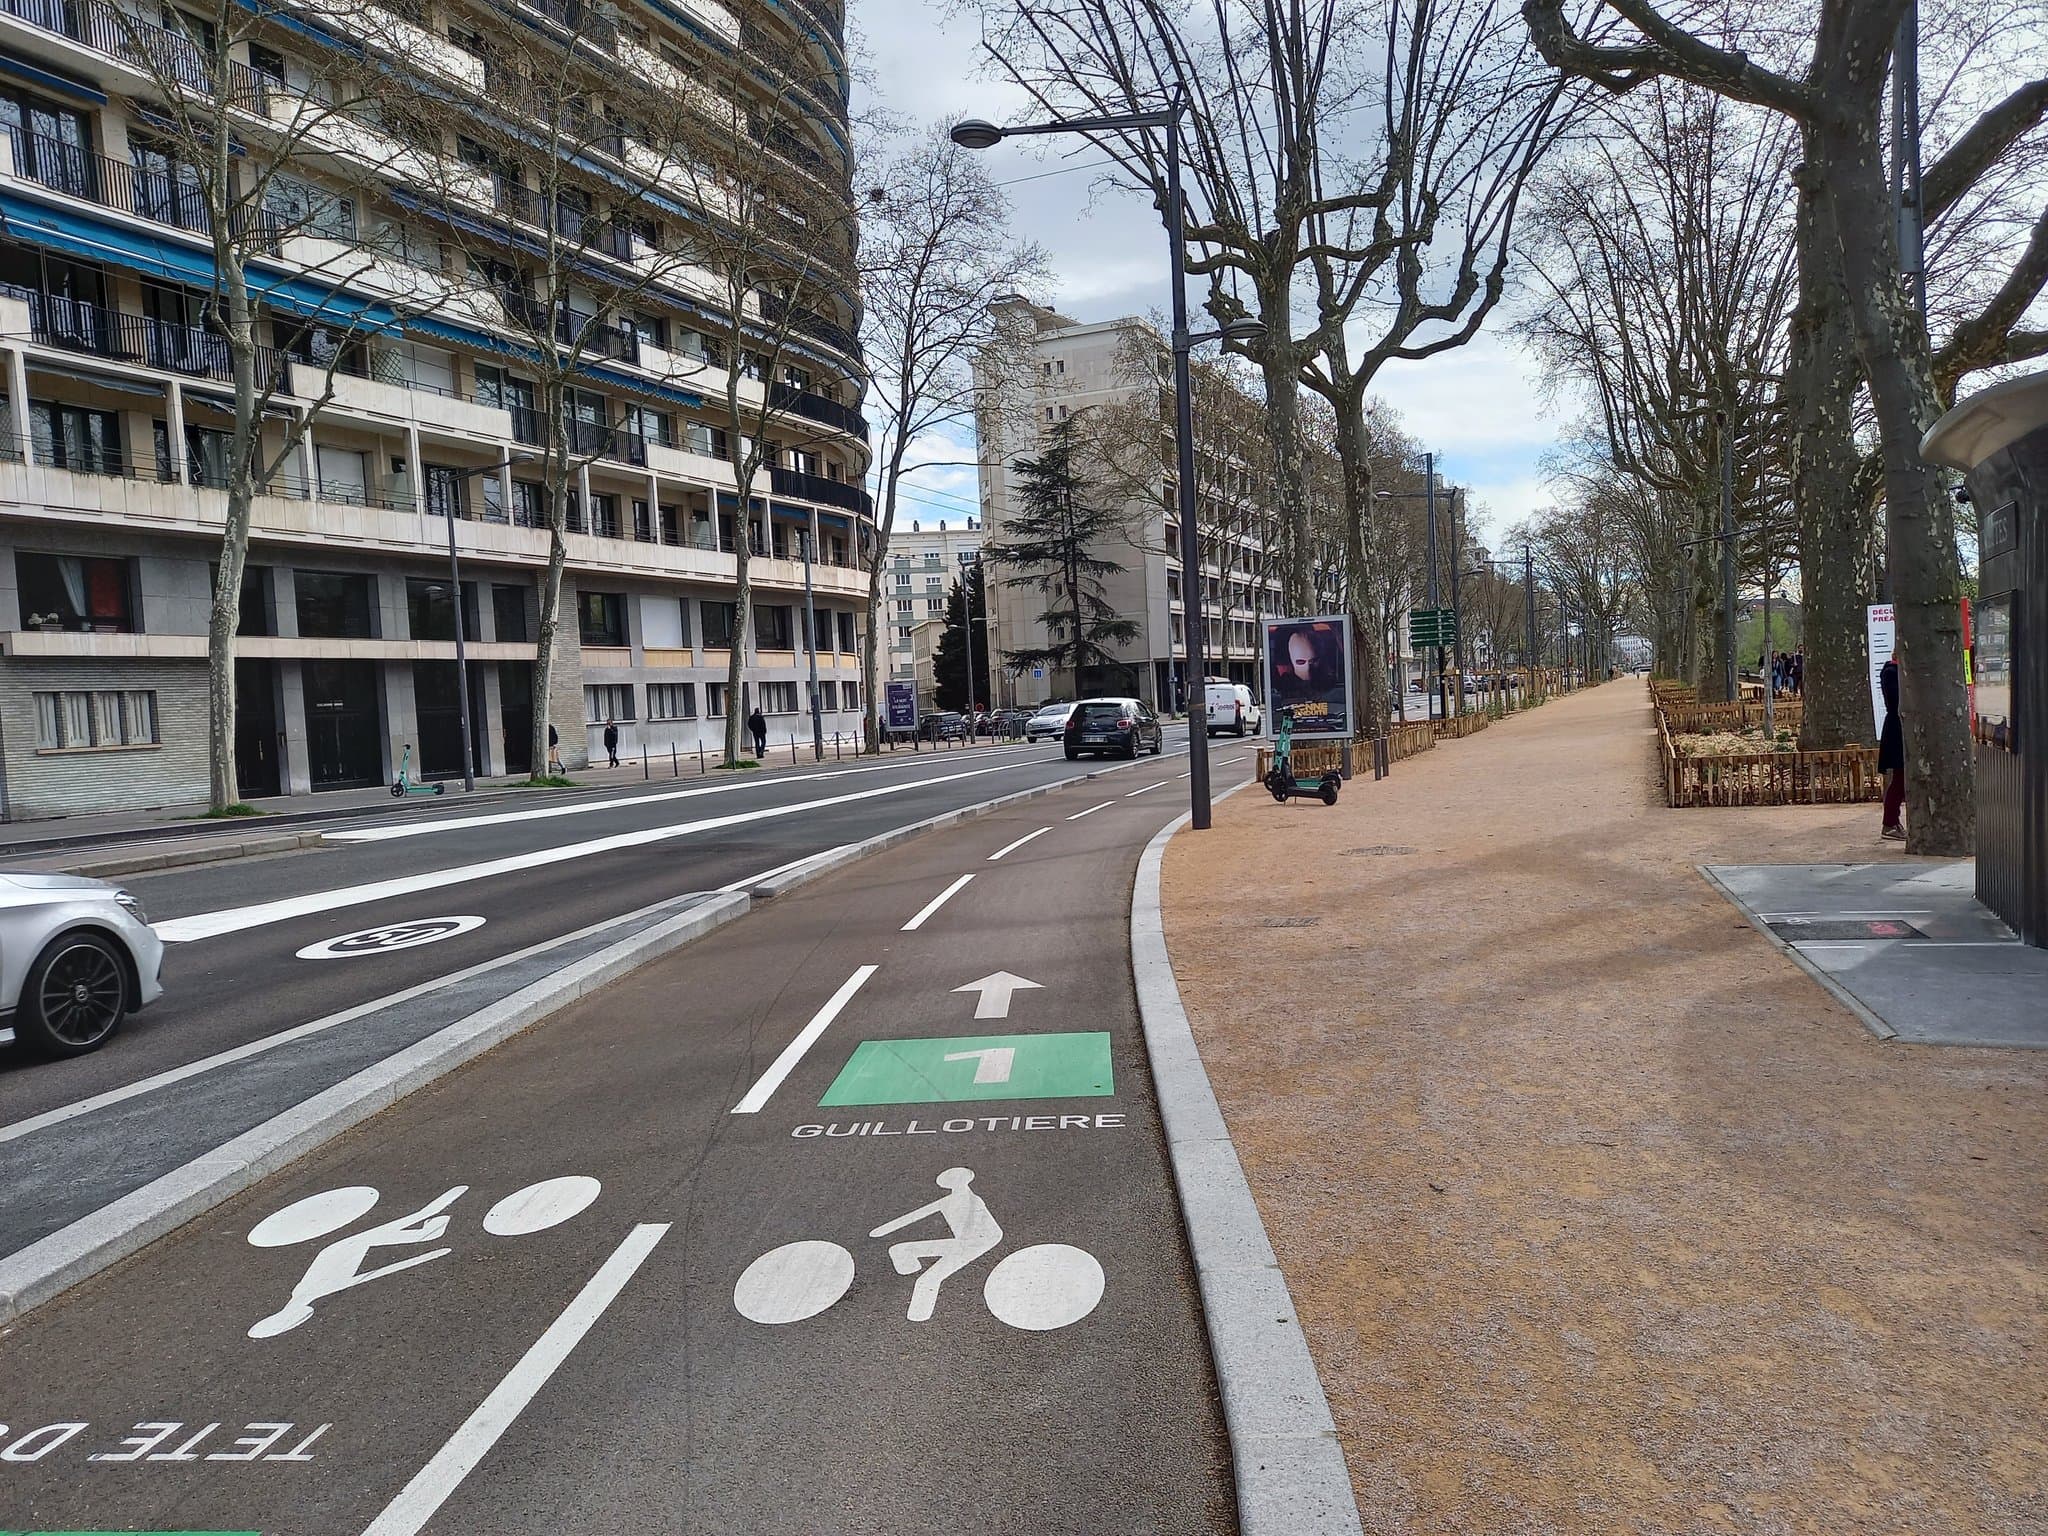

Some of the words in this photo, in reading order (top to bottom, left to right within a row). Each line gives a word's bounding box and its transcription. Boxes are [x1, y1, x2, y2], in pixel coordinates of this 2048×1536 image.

[942, 1047, 1015, 1084] 1
[790, 1113, 1126, 1139] GUILLOTIERE
[87, 1422, 335, 1462] TETE
